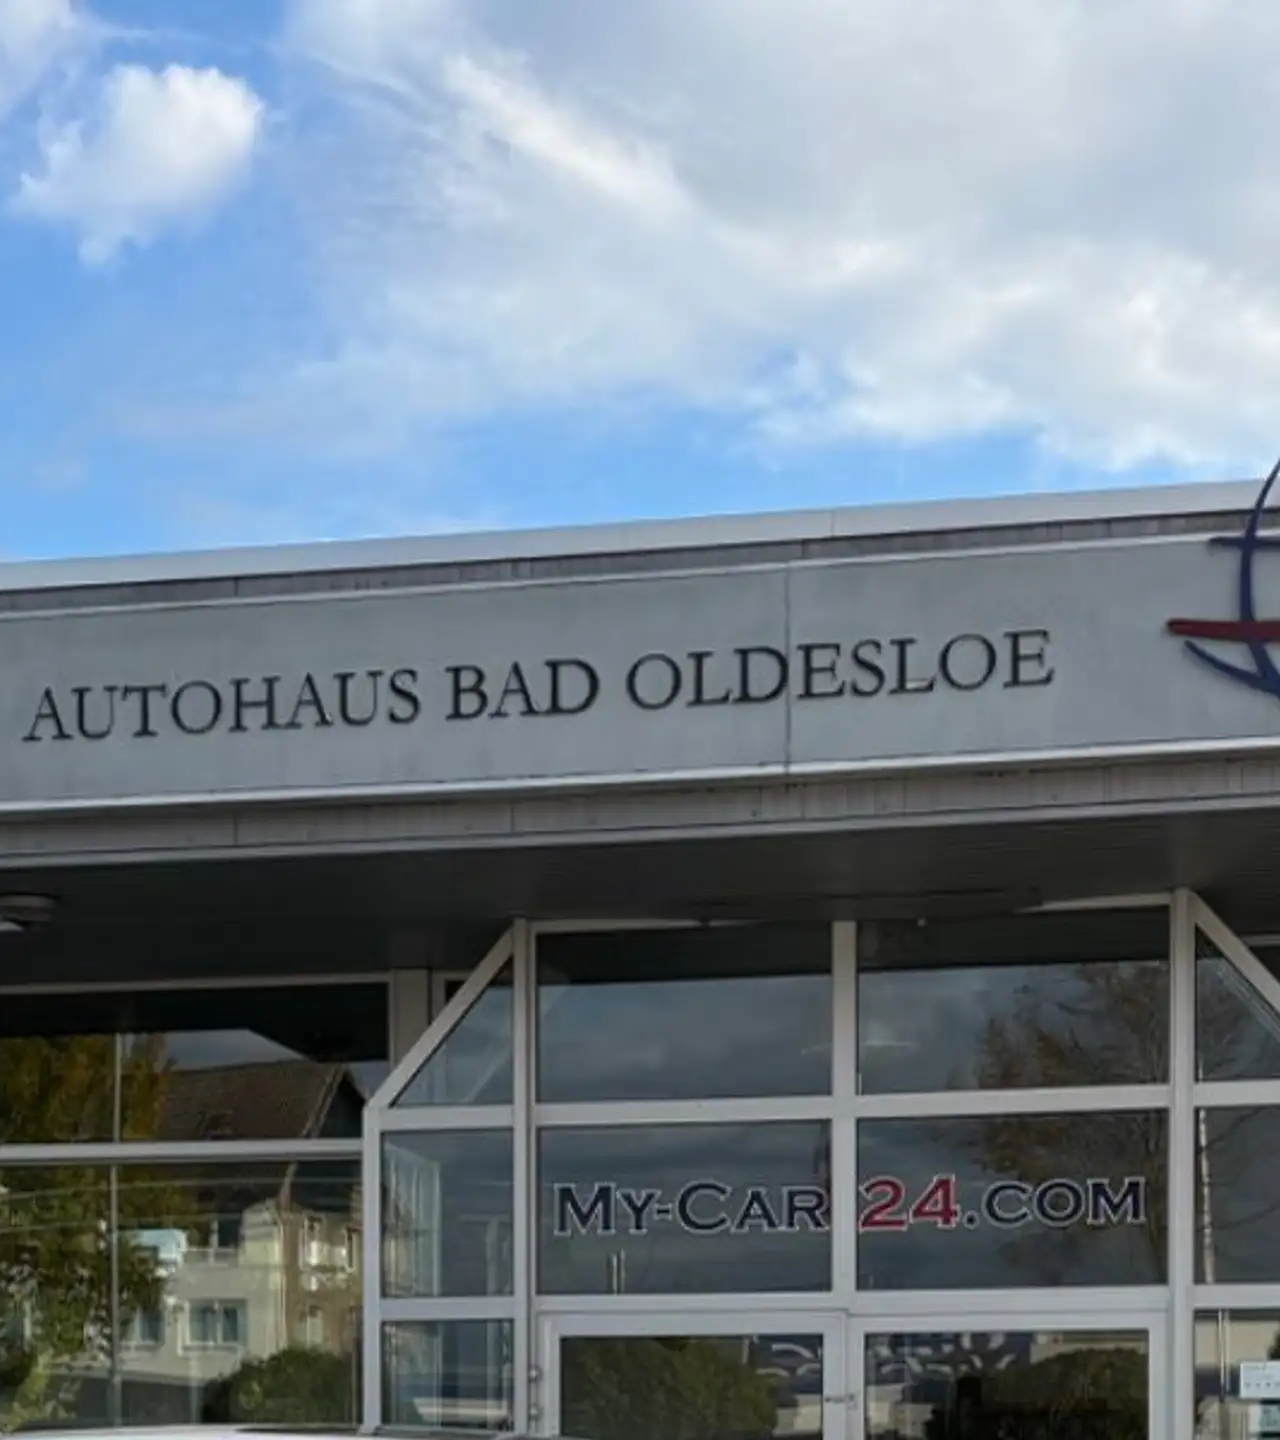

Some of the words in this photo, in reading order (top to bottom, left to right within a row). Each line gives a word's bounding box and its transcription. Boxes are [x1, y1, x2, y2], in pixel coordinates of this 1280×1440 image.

[22, 668, 421, 742] AUTOHAUS
[444, 657, 601, 723] BAD
[625, 628, 1055, 711] OLDESLOE
